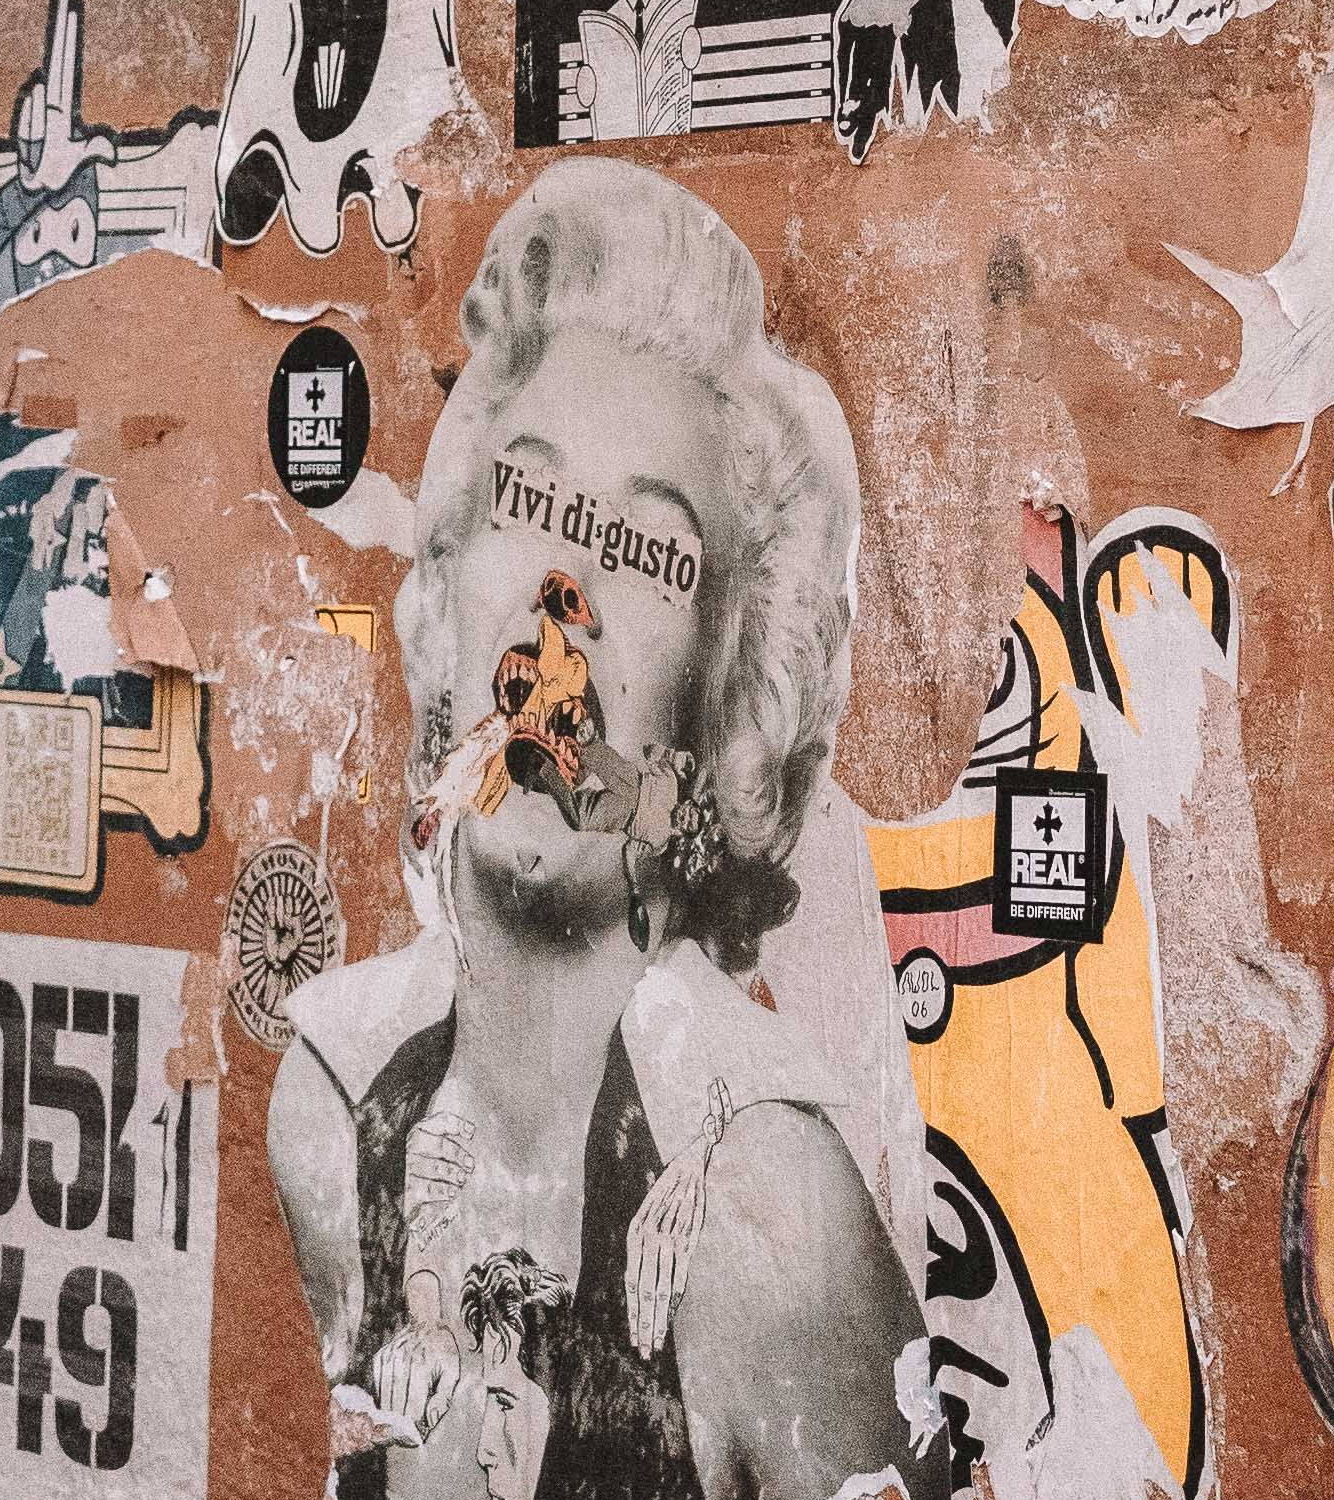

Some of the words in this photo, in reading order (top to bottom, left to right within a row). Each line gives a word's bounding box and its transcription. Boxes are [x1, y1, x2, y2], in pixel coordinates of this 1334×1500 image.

[288, 464, 299, 474] BE
[300, 464, 342, 475] DIFFERENT
[494, 460, 556, 533] Vivi
[1011, 904, 1024, 918] BE
[1027, 904, 1085, 921] DIFFERENT
